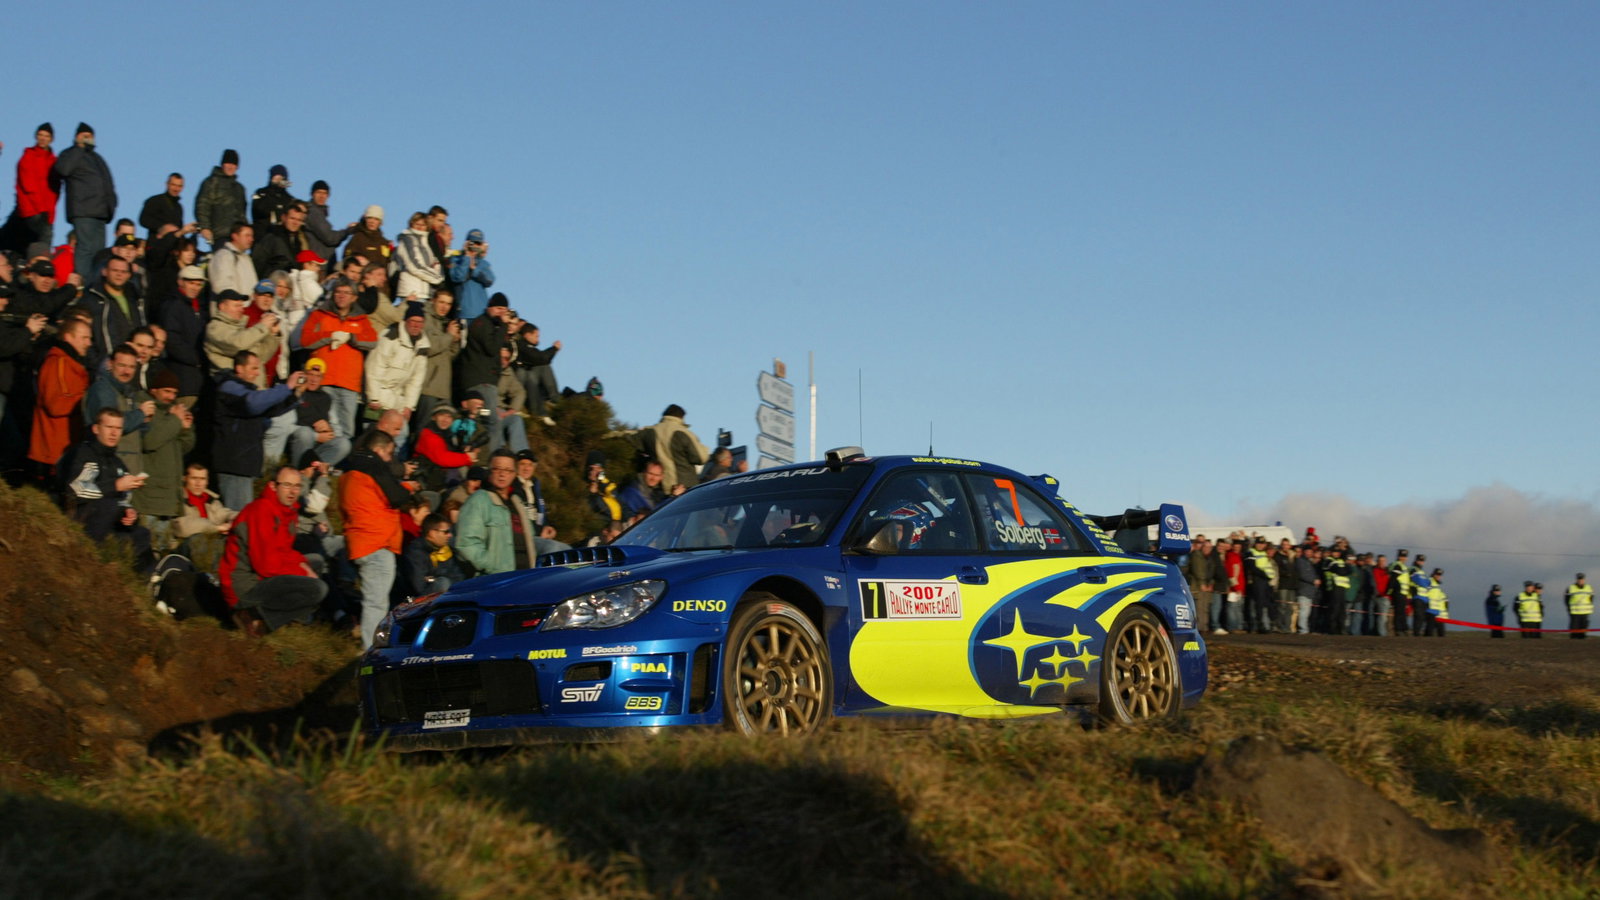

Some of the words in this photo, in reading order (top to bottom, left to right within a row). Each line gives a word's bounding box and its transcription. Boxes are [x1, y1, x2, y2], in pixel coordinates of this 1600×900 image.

[729, 467, 829, 485] SUBARU
[993, 479, 1025, 527] 7
[994, 520, 1047, 550] Solberg
[1164, 532, 1191, 541] SUBARU
[902, 585, 943, 600] 2007
[672, 599, 727, 612] DENSO
[867, 582, 879, 618] 7
[889, 590, 914, 615] RALLYE
[527, 648, 567, 660] MOTUL
[581, 644, 637, 657] BFGoodrich
[630, 662, 667, 673] PIAA
[625, 696, 662, 710] BBS
